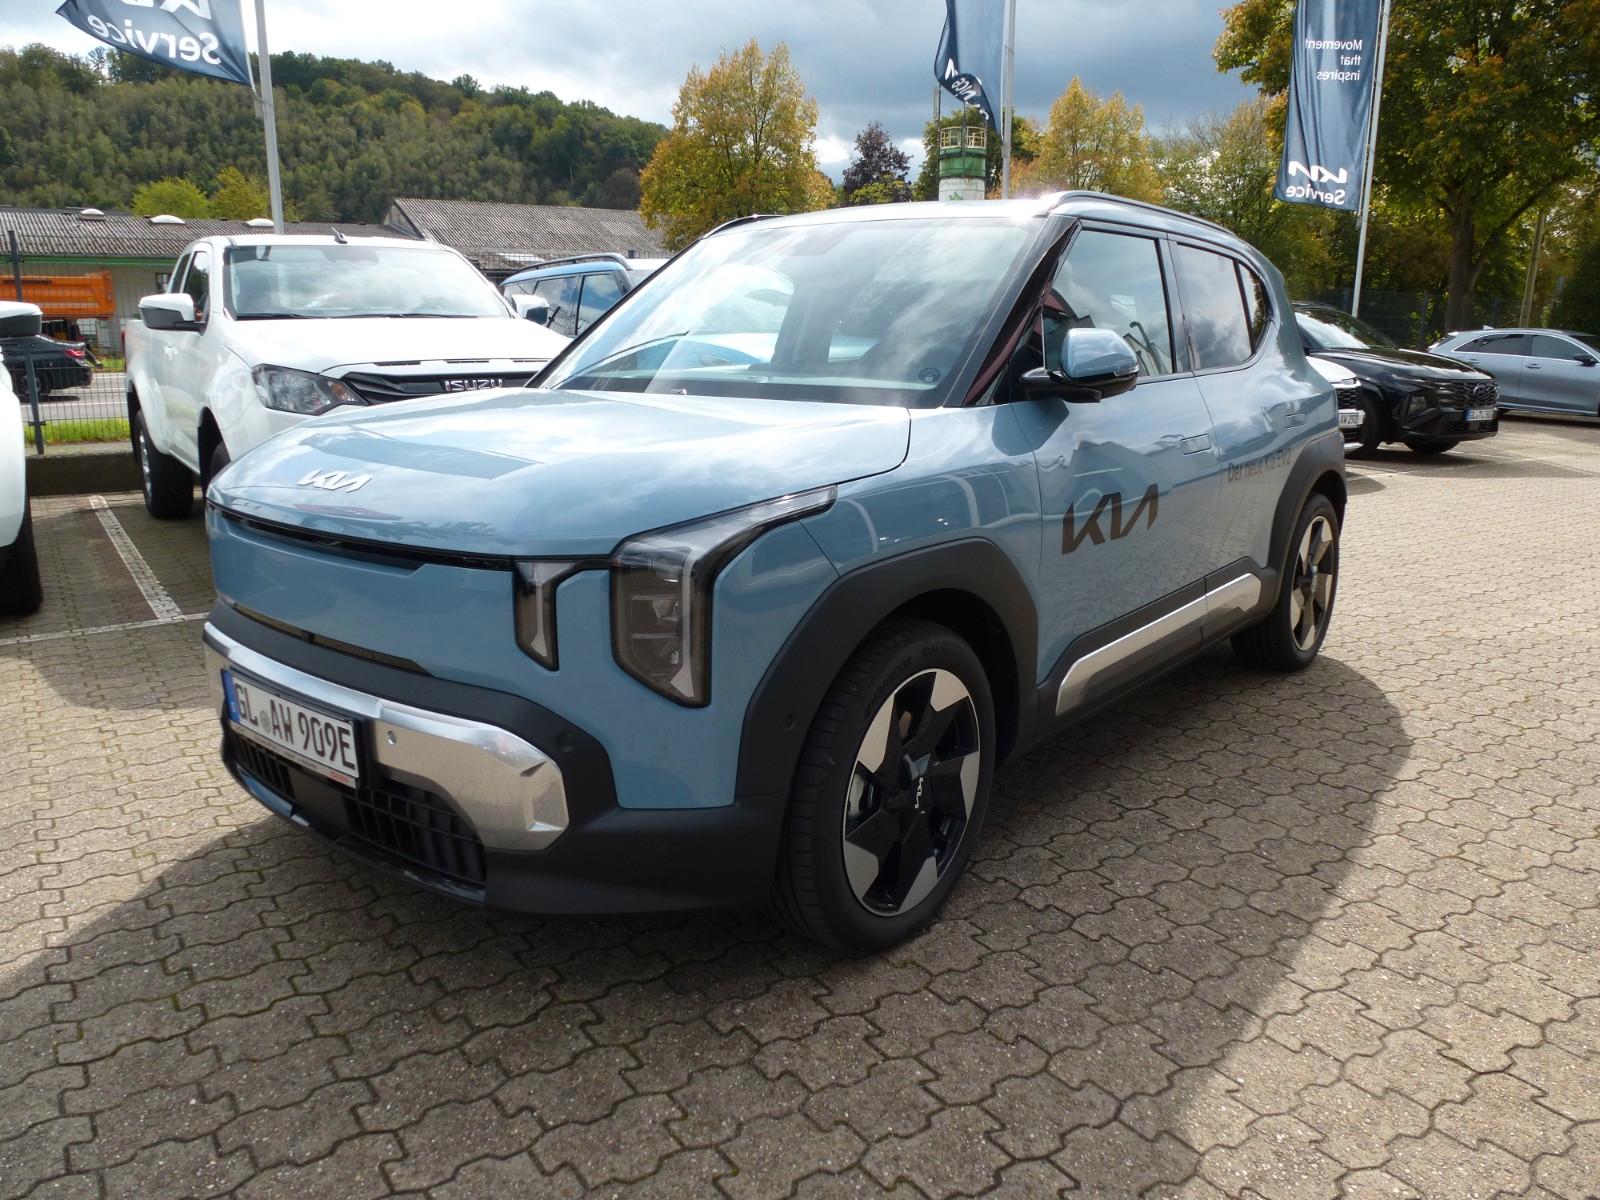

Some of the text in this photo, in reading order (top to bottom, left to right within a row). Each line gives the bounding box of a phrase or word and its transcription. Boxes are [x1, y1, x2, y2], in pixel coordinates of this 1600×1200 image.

[445, 379, 503, 391] ISUZU
[296, 468, 376, 494] KIA
[1062, 483, 1158, 556] KIA
[234, 682, 258, 727] GL
[270, 699, 294, 745] AW
[298, 711, 356, 771] 909E
